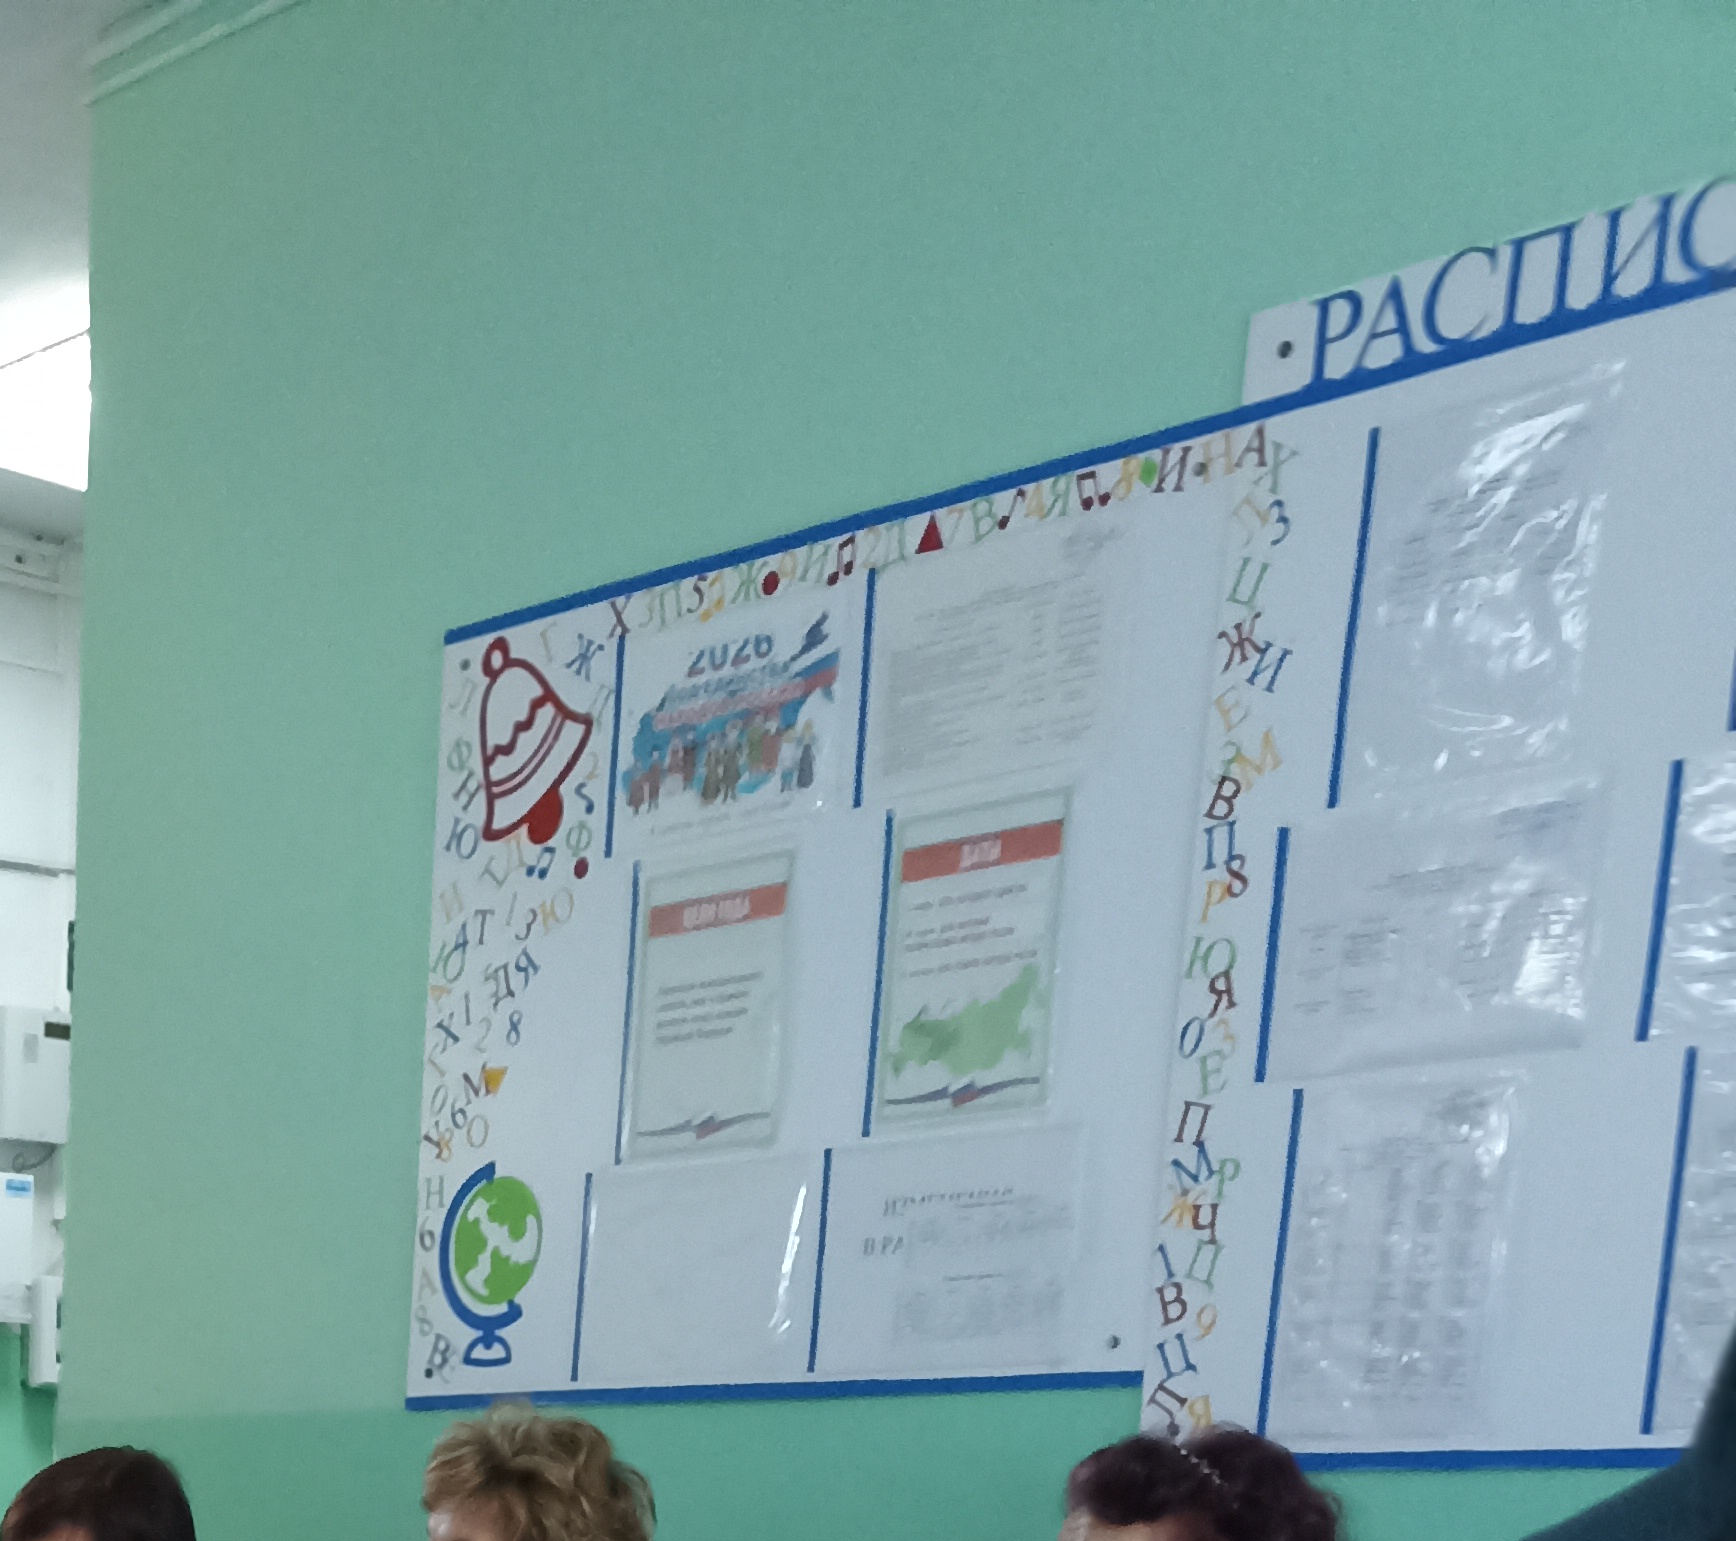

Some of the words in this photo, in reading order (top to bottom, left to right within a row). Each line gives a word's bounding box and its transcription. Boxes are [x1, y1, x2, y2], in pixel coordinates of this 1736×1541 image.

[1312, 174, 1736, 384] РАСПИС
[474, 909, 495, 945] Т
[1185, 936, 1237, 979] Ю
[1208, 969, 1238, 1018] Я
[506, 1010, 523, 1047] 8
